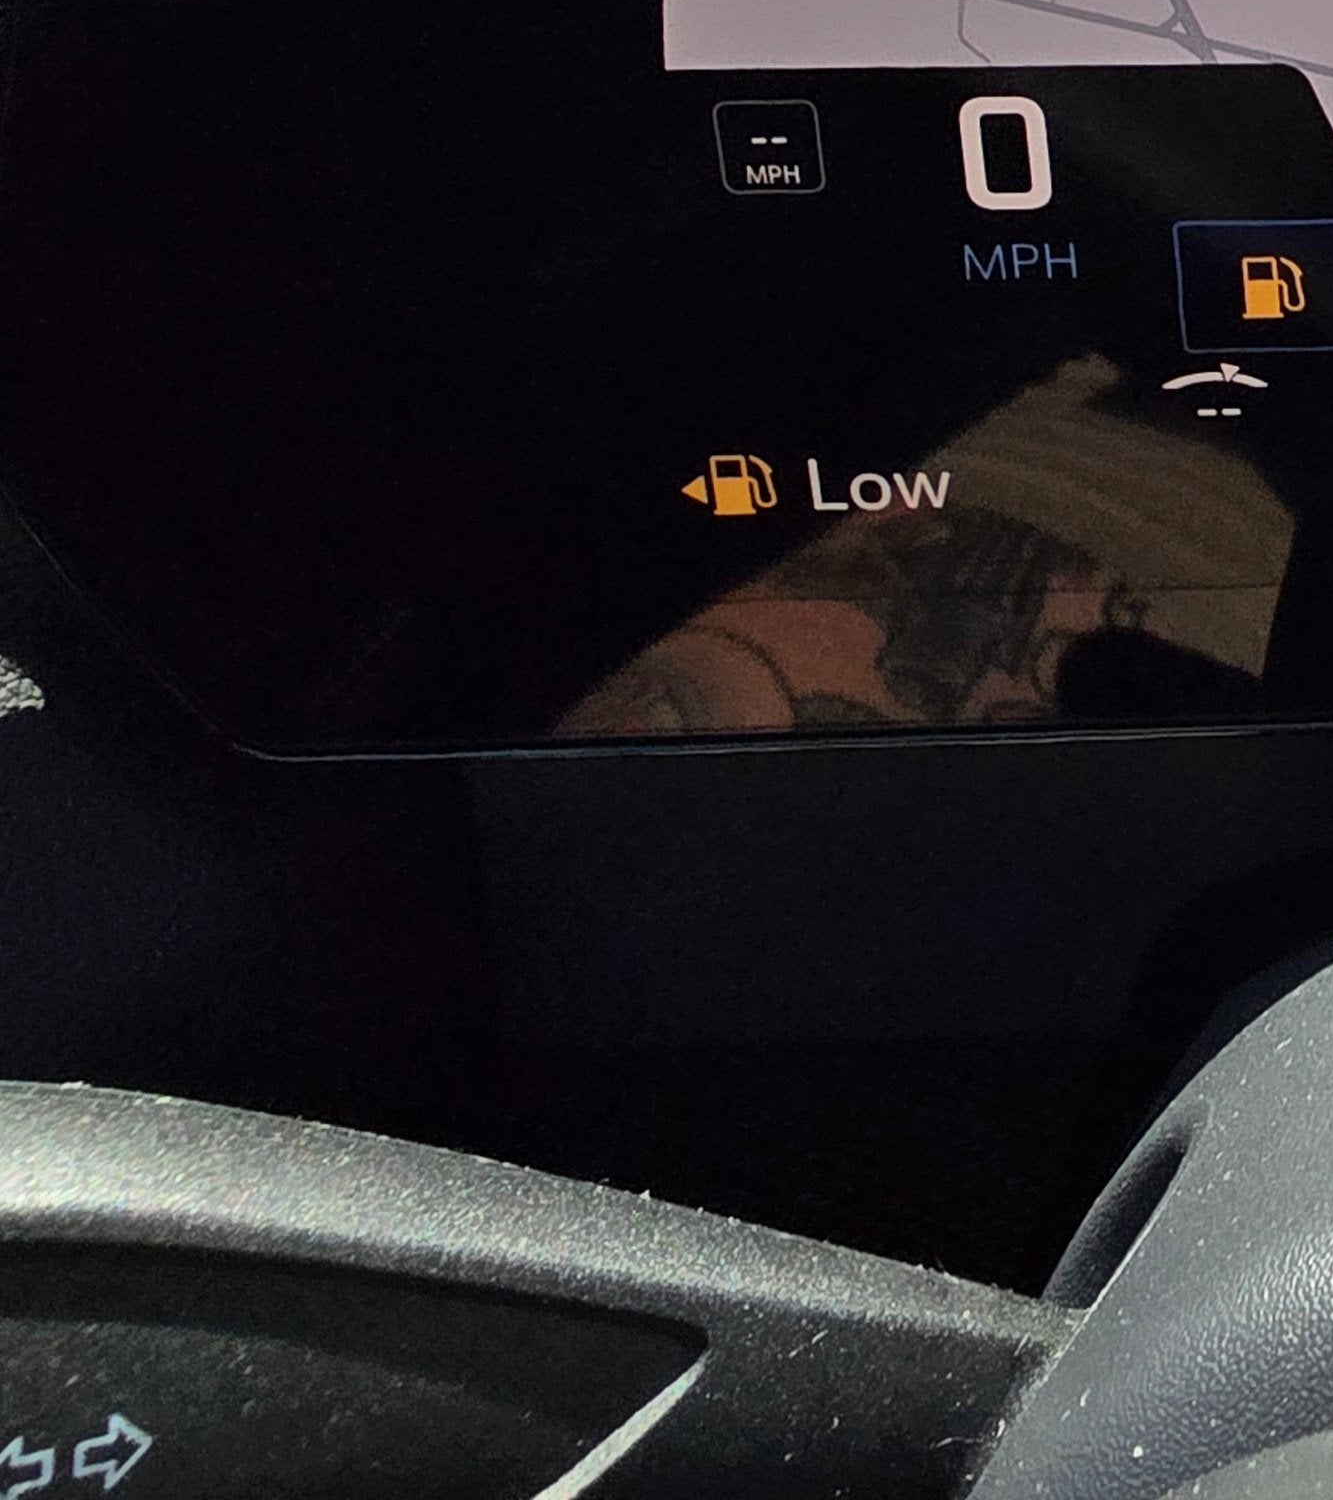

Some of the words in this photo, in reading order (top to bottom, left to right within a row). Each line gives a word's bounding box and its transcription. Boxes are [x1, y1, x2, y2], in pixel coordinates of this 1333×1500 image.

[746, 164, 802, 185] MPH
[958, 96, 1053, 211] 0
[963, 242, 1078, 281] MPH
[807, 457, 951, 512] Low
